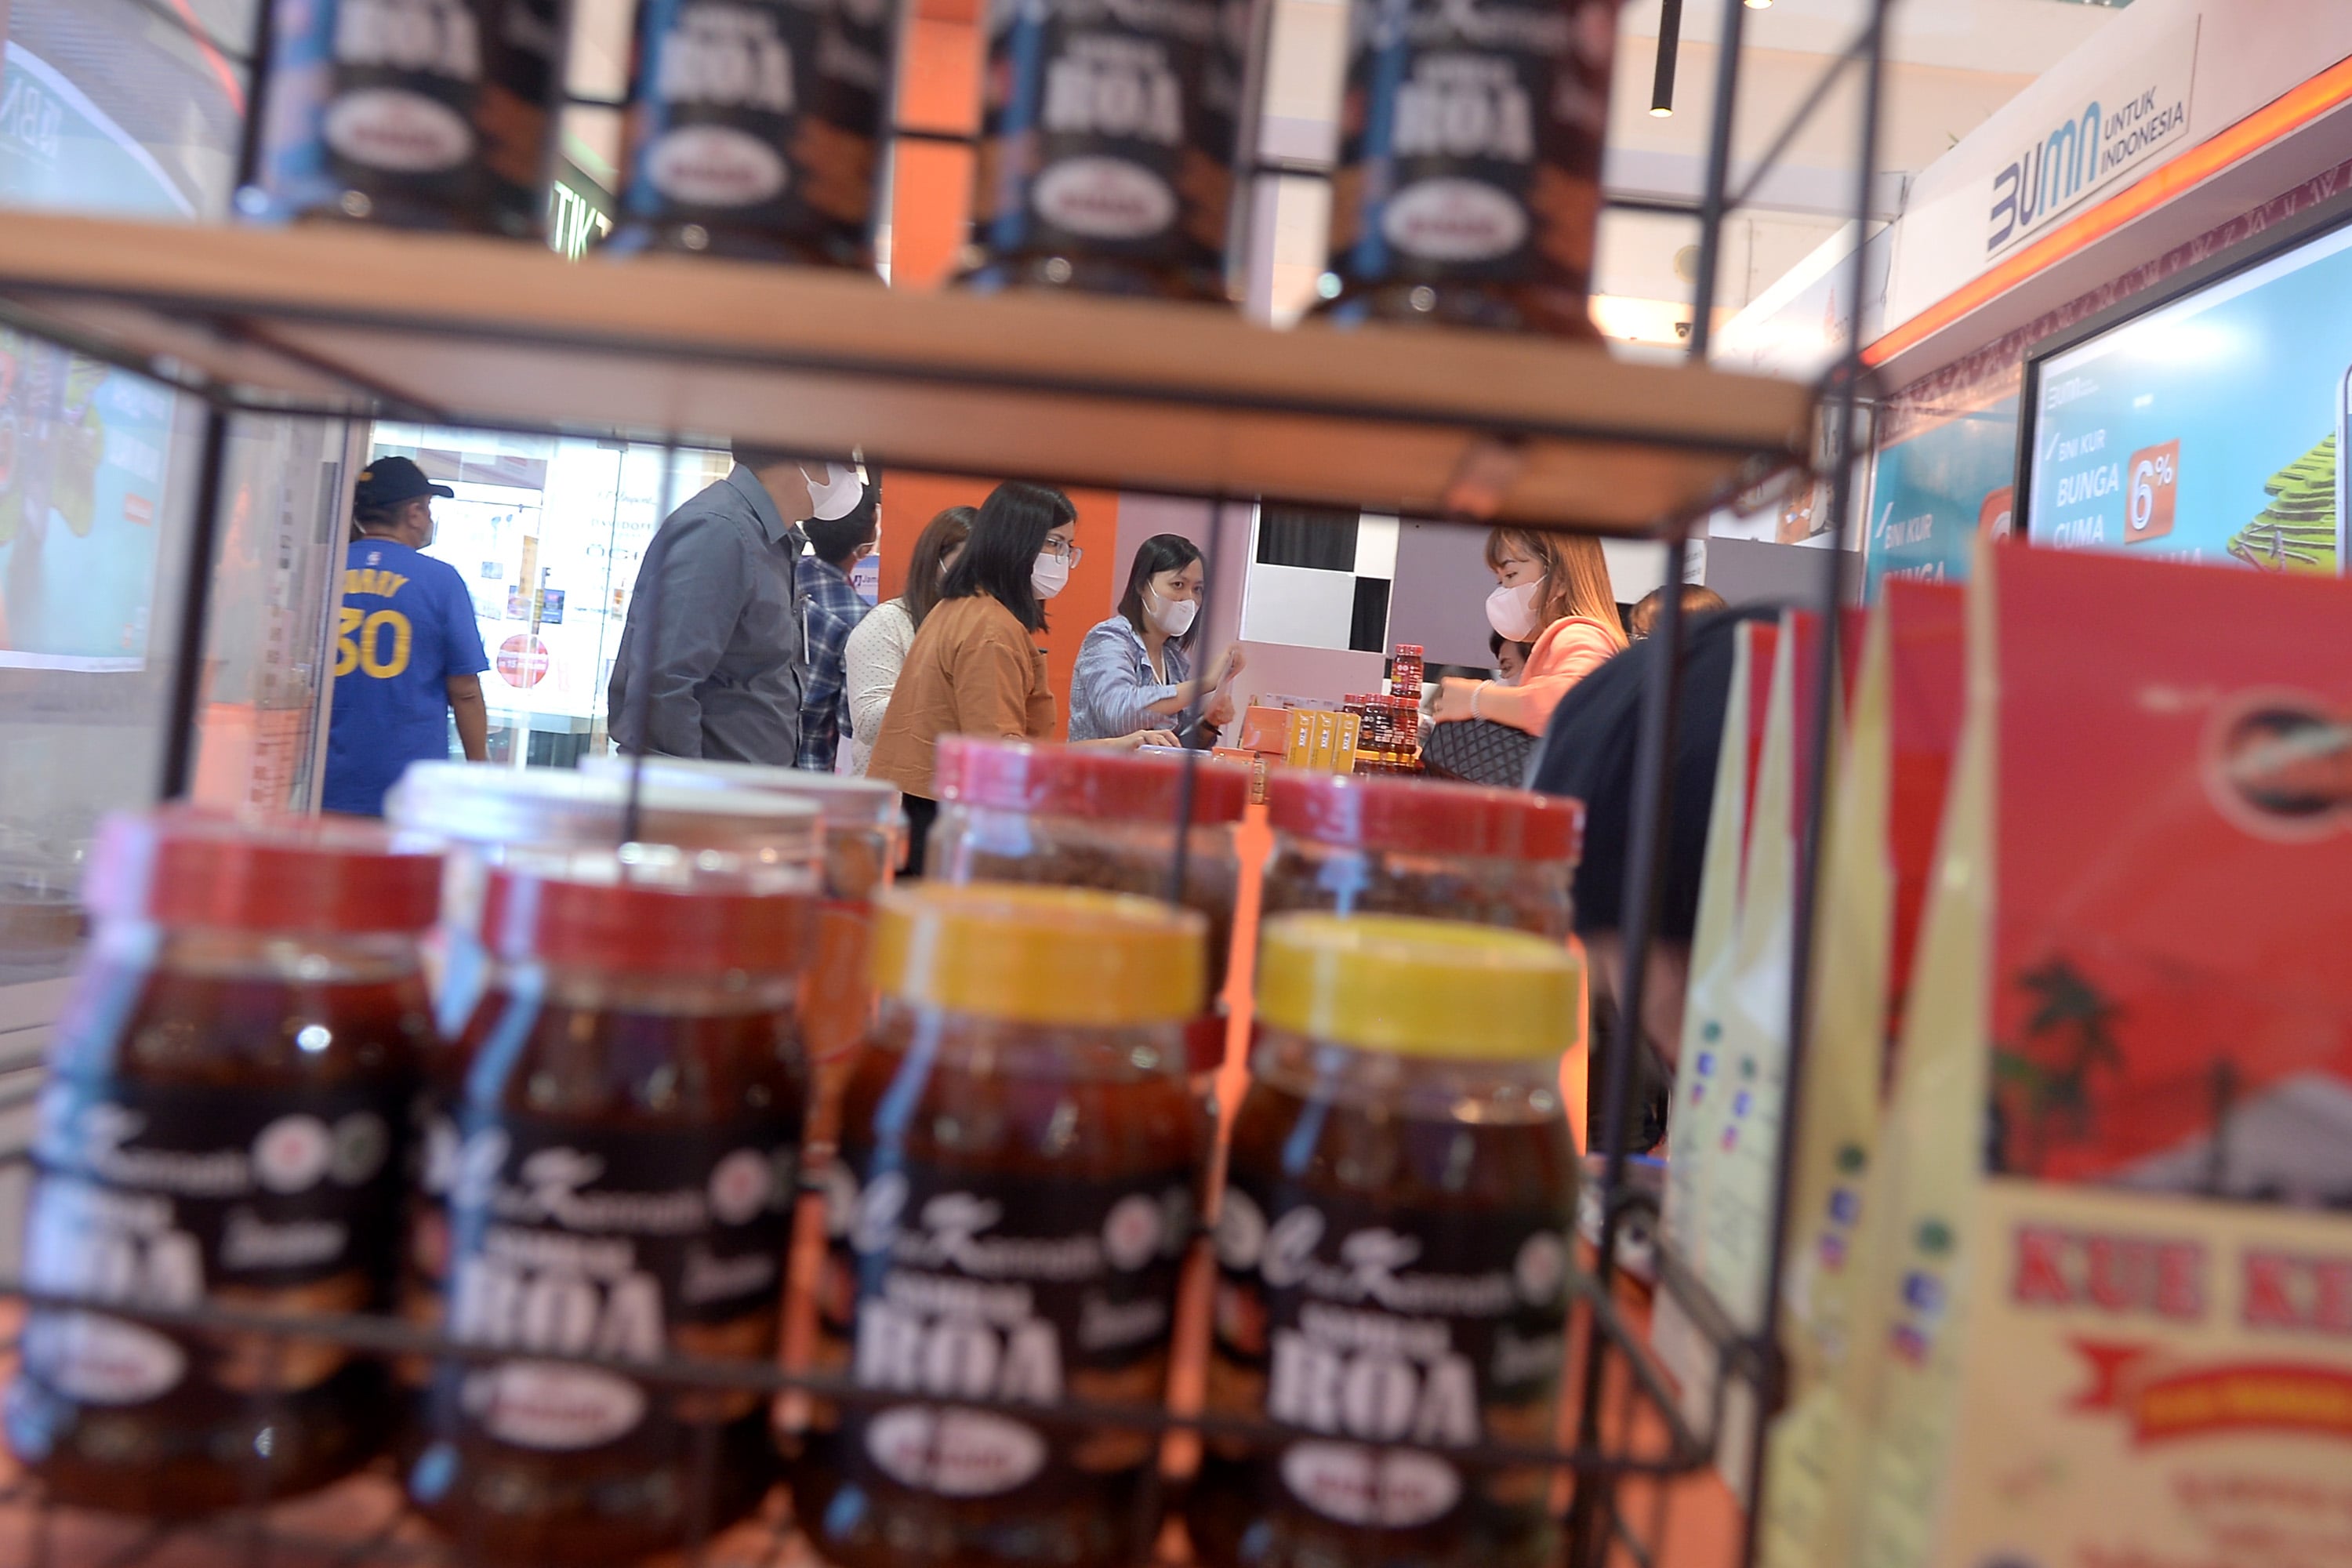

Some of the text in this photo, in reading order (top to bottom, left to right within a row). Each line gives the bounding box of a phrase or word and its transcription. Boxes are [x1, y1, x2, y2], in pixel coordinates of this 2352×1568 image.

[2104, 85, 2157, 140] UNTUK
[2101, 101, 2183, 174] INDONESIA
[2058, 429, 2106, 461] BNI KUR
[2056, 463, 2119, 507] BUNGA
[2053, 514, 2104, 550] CUMA
[335, 606, 413, 680] 30
